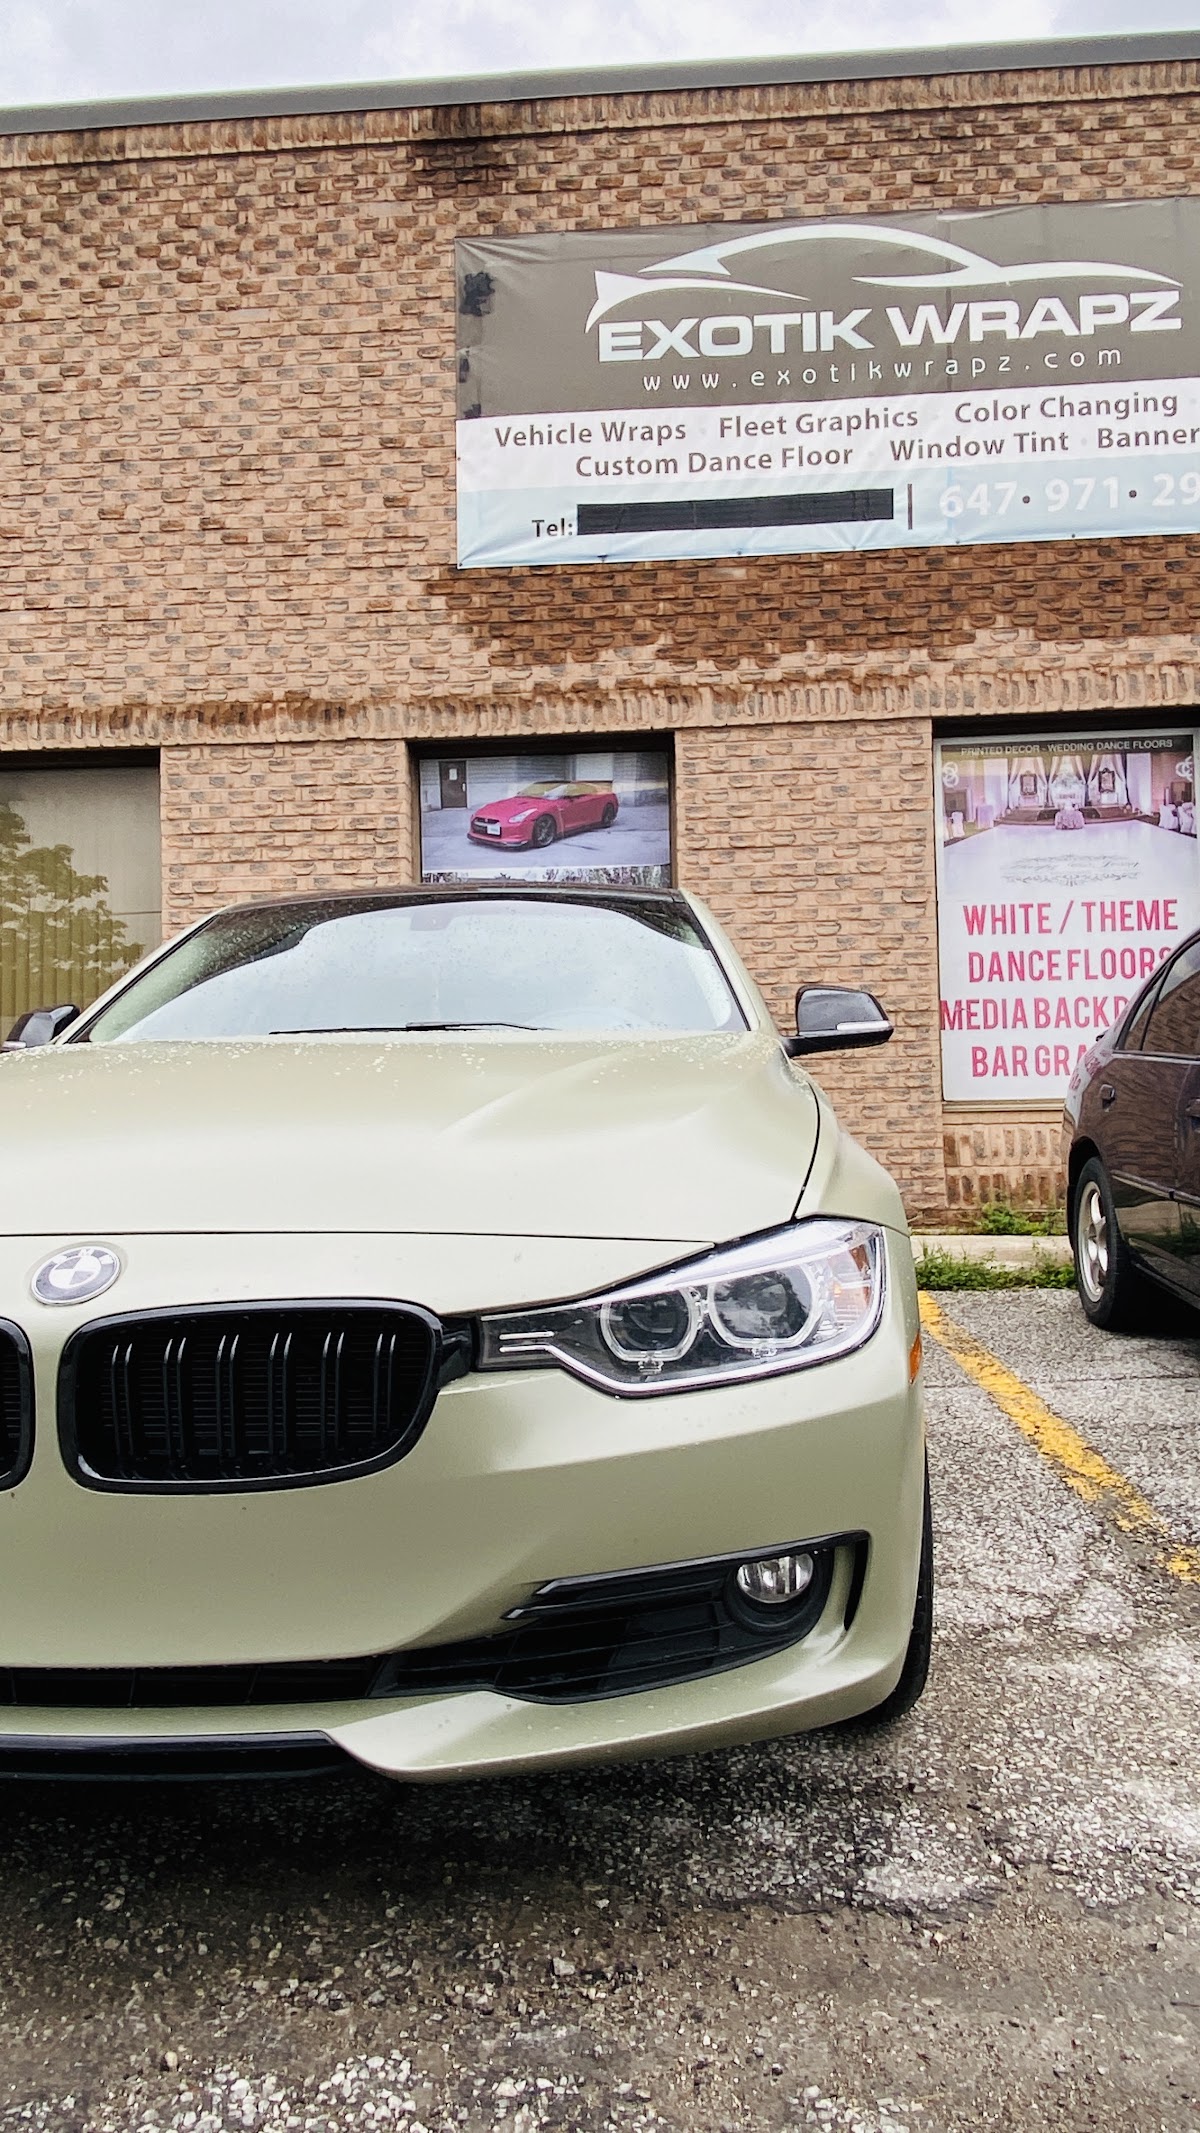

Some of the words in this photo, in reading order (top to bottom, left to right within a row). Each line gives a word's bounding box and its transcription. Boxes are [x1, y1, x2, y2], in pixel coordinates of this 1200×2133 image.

[599, 308, 875, 362] EXOTIK
[885, 290, 1183, 346] WRAPZ
[495, 422, 593, 447] Vehicle
[600, 420, 687, 447] Wraps
[719, 415, 787, 439] Fleet
[795, 407, 919, 436] Graphics
[955, 399, 1031, 423] Color
[1040, 392, 1178, 420] Changing
[576, 455, 679, 477] Custom
[688, 451, 772, 474] Dance
[781, 446, 853, 468] Floor
[890, 436, 1005, 461] Window
[1013, 431, 1069, 453] Tint
[531, 518, 573, 537] Tel:
[961, 745, 1003, 756] PRINTED
[1005, 744, 1040, 754] DECOR
[1048, 742, 1094, 752] WEDDING
[1096, 740, 1130, 750] DANCE
[1132, 739, 1173, 749] FLOORS
[963, 902, 1052, 936] WHITE
[1081, 898, 1178, 932] THEME
